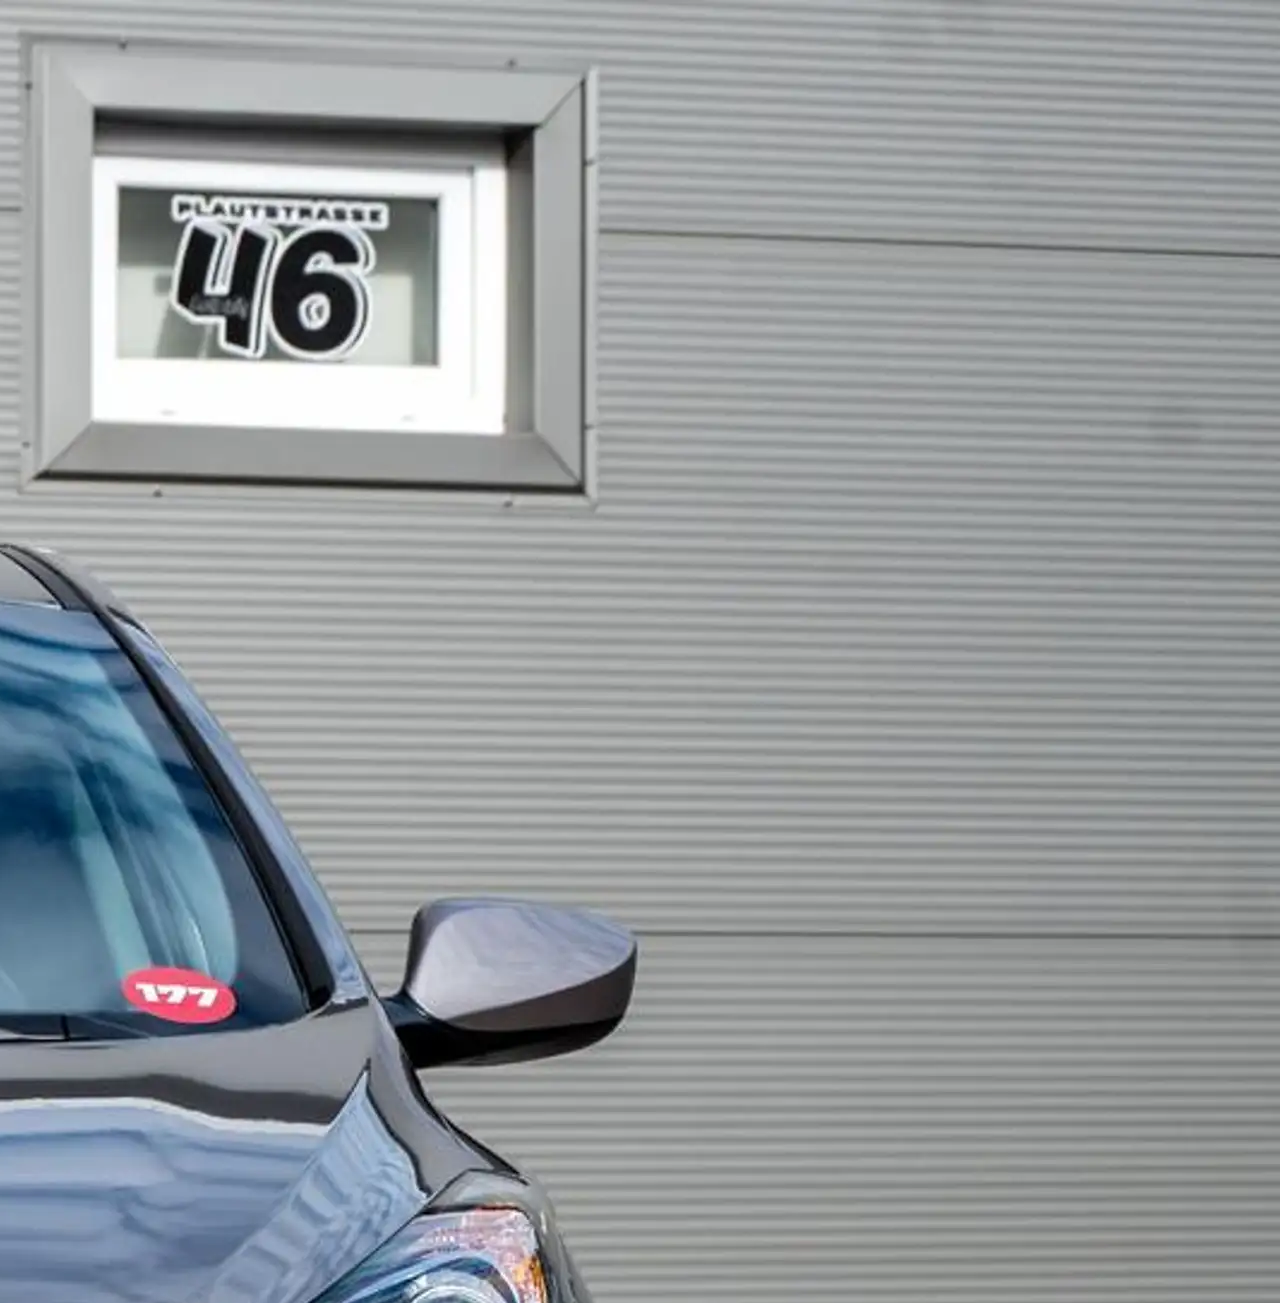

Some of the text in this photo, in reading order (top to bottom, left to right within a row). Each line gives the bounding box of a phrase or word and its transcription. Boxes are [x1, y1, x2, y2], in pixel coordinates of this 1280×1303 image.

[175, 198, 385, 225] PLAUTSTRASSE
[173, 219, 372, 356] 46
[135, 982, 218, 1008] 177
